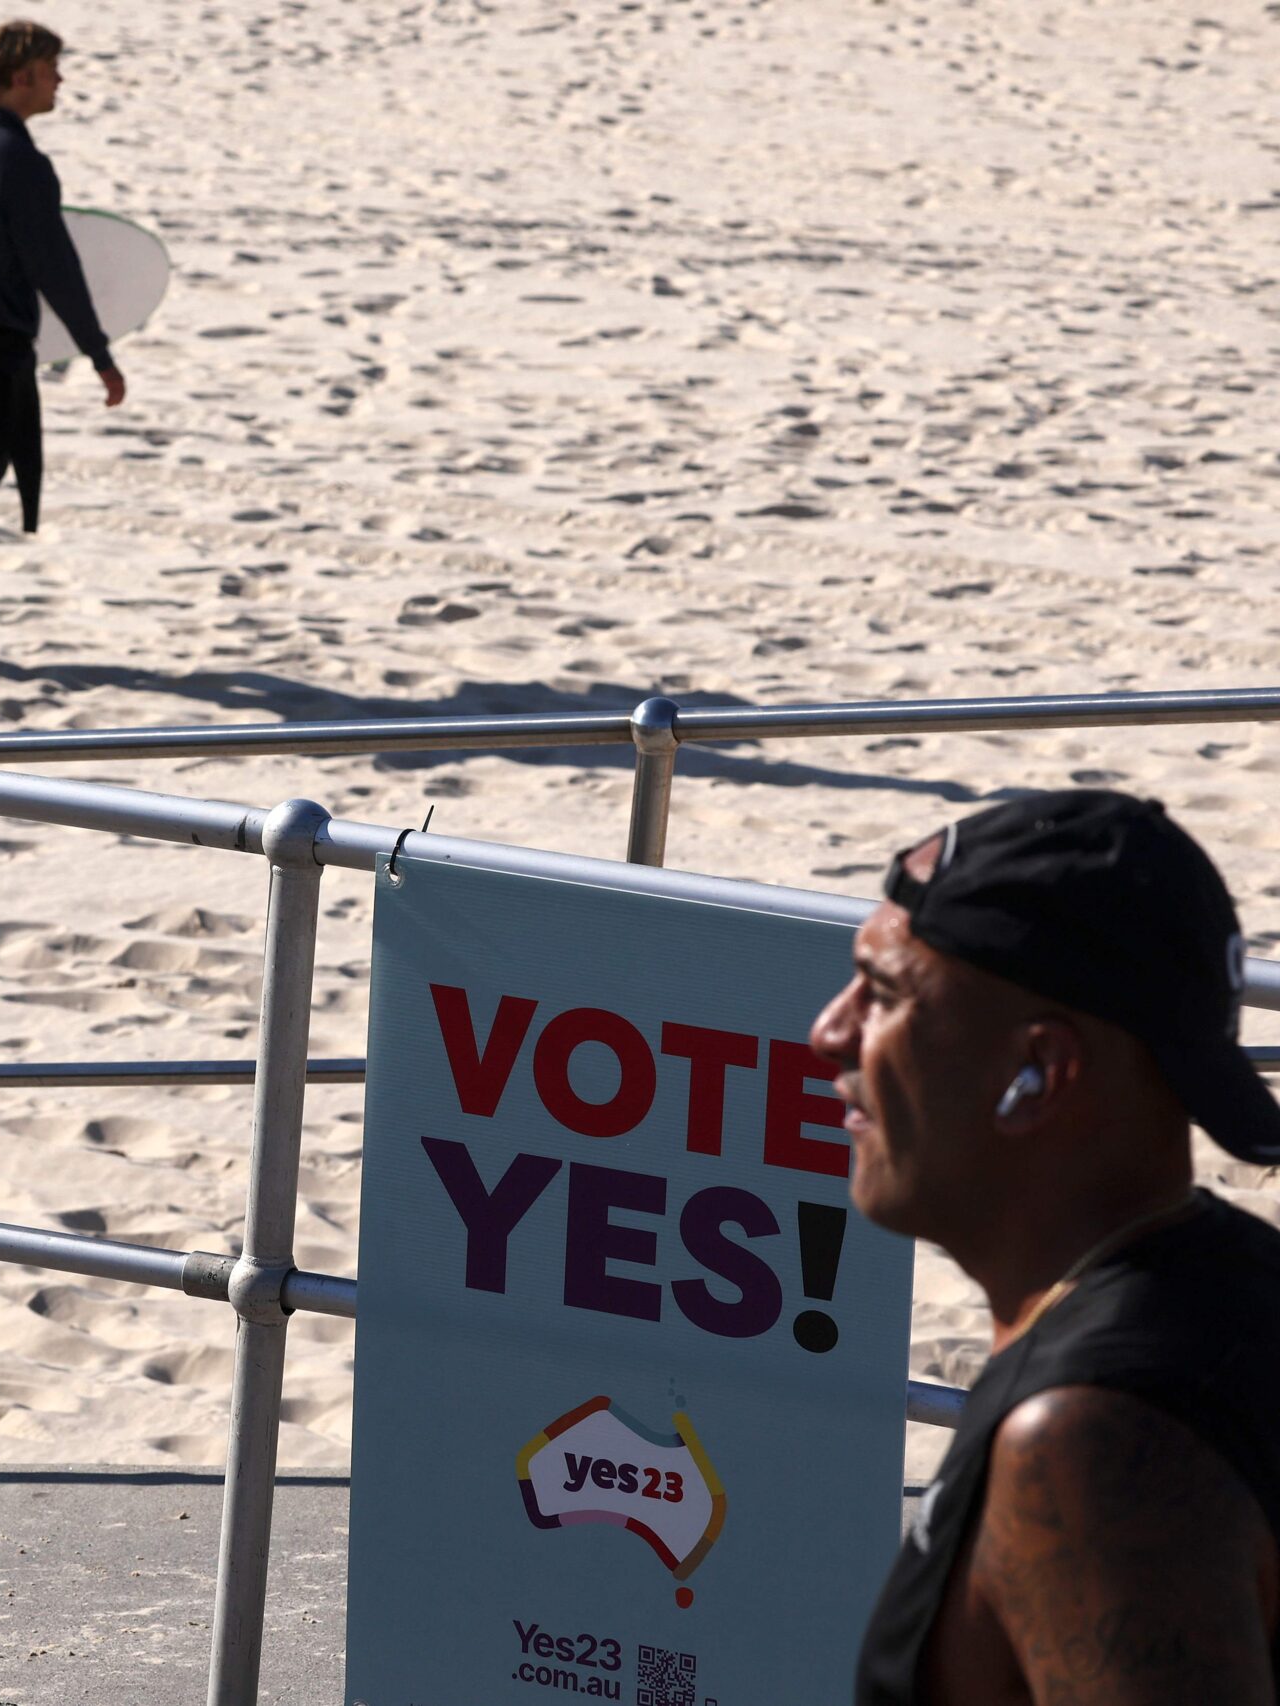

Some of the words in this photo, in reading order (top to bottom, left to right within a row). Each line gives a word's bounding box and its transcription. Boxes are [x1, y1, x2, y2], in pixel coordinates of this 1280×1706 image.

[429, 982, 851, 1178] VOTE
[420, 1135, 847, 1354] YES!
[563, 1452, 684, 1503] yes23
[512, 1619, 622, 1672] Yes23
[511, 1661, 621, 1701] .com.au
